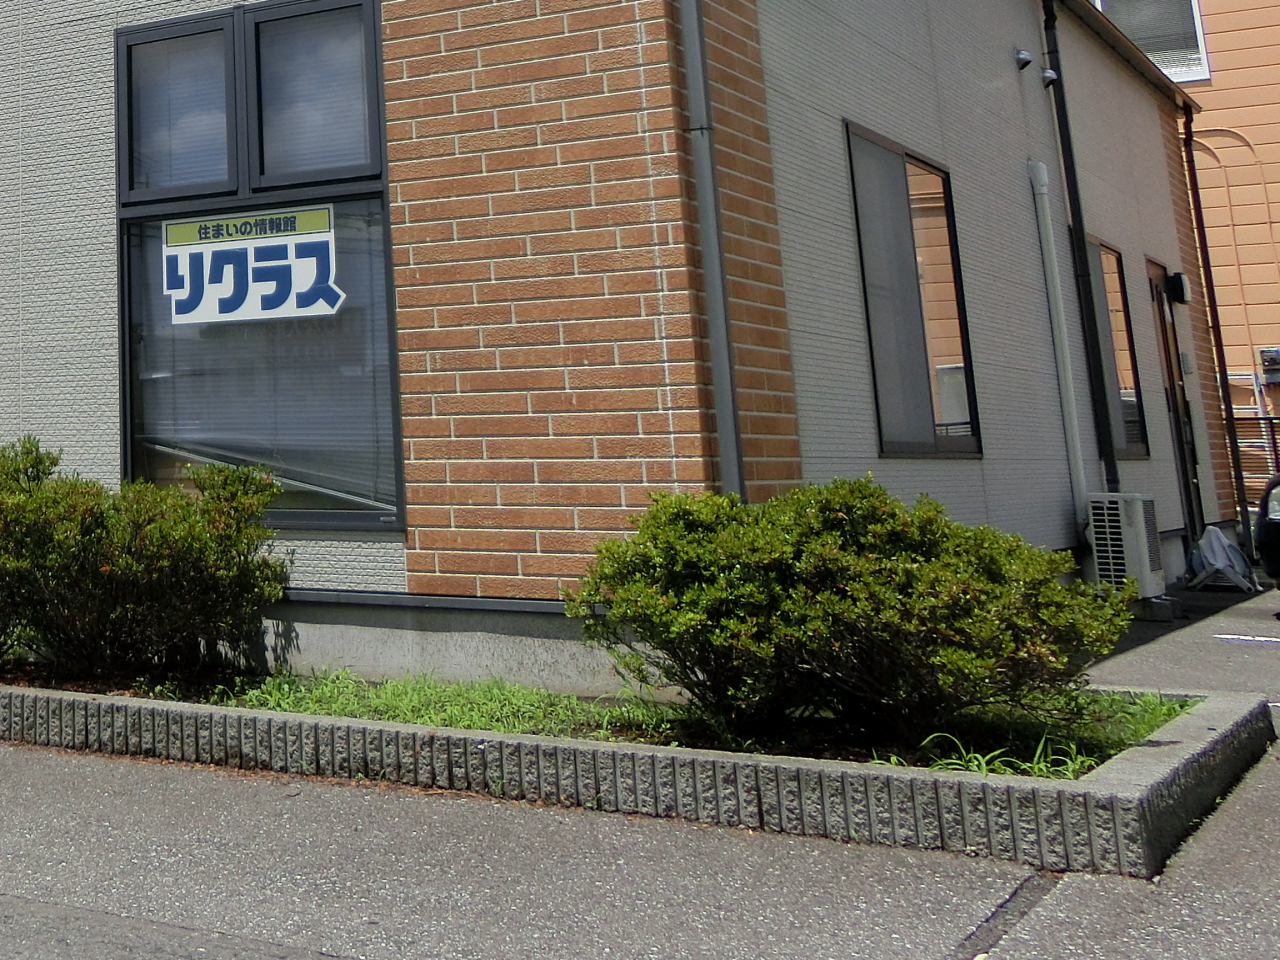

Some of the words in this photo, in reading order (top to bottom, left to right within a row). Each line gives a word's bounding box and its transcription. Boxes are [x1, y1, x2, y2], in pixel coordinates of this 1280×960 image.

[197, 215, 297, 241] 住まいの情報館
[166, 240, 342, 315] リクラス
